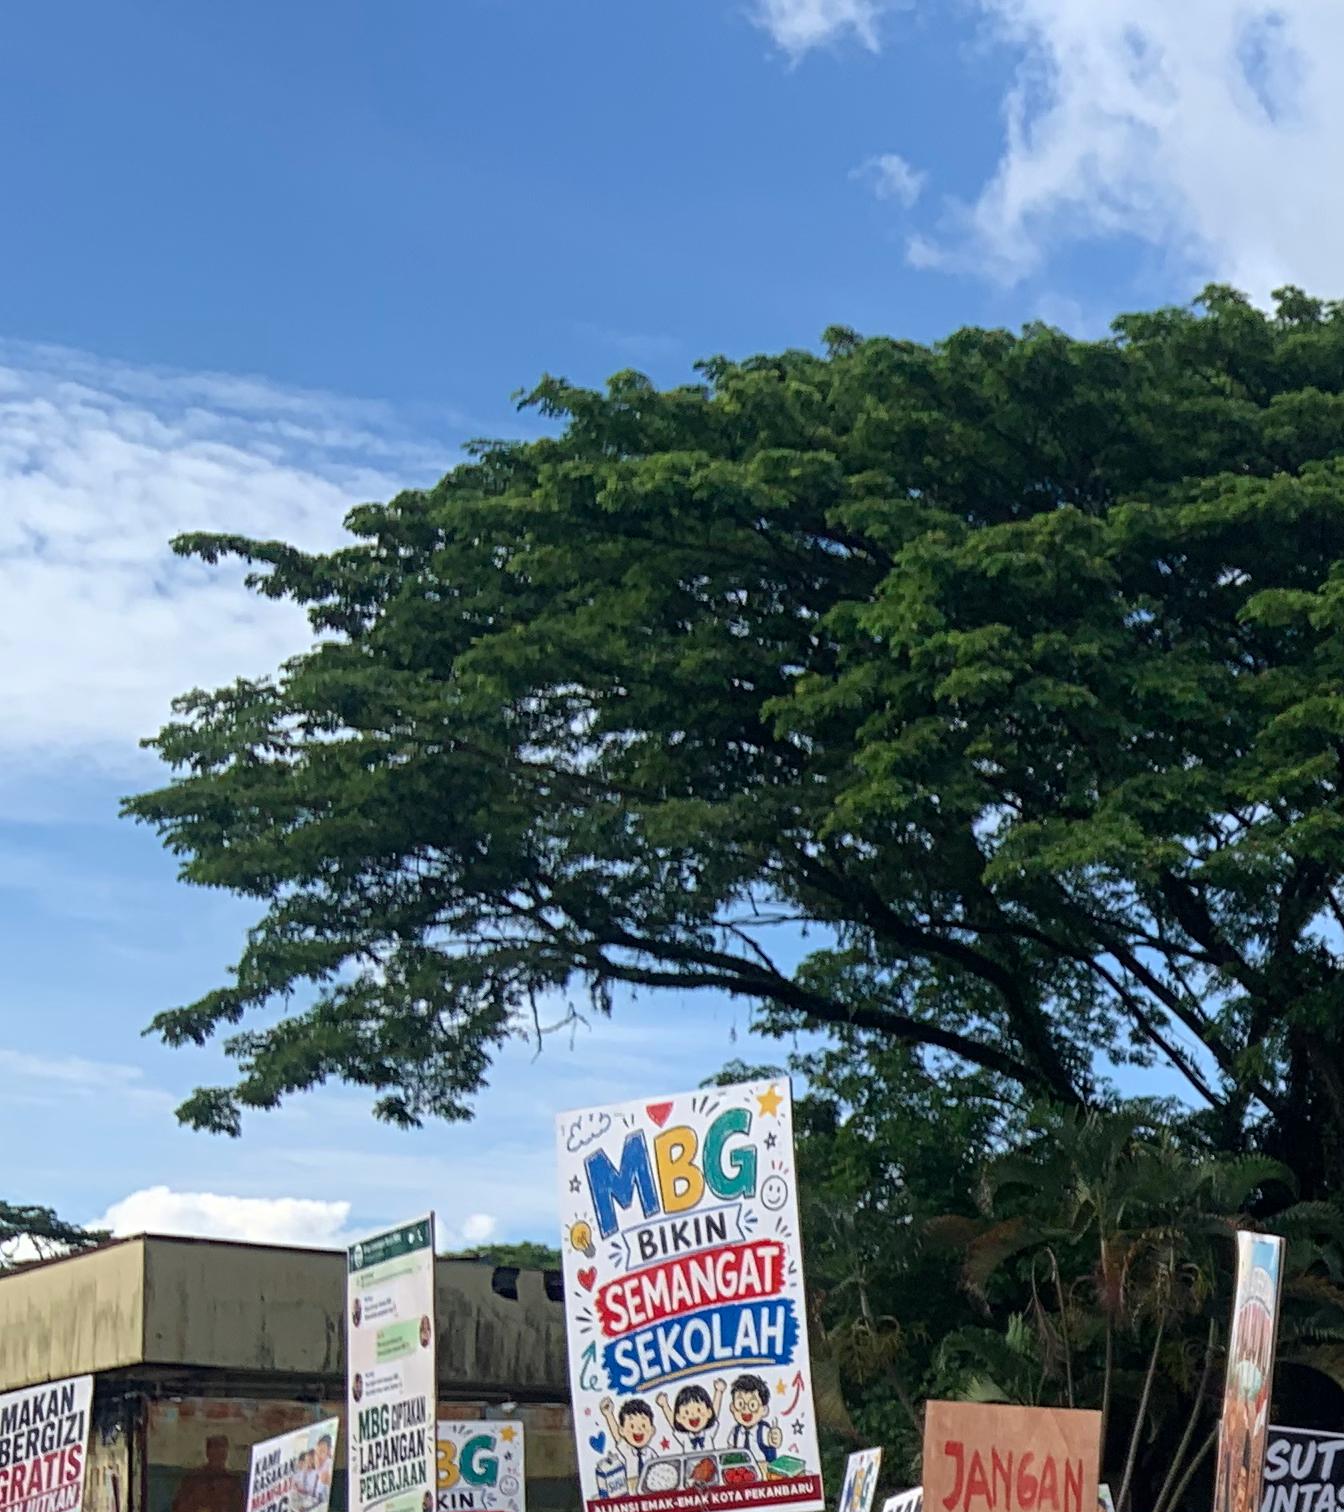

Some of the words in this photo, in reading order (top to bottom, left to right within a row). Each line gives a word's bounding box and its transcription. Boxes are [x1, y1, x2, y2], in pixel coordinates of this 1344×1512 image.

[584, 1107, 758, 1240] MBG
[638, 1212, 727, 1260] BIKIN
[608, 1246, 779, 1333] SEMANGAT
[0, 1383, 74, 1436] MAKAN
[359, 1403, 390, 1444] MBG
[360, 1429, 425, 1474] LAPANGAN
[359, 1461, 427, 1503] PEKERJAAN
[641, 1494, 709, 1512] EMAK-EMAK
[712, 1490, 743, 1505] KOTA
[744, 1482, 814, 1500] PEKANBARU
